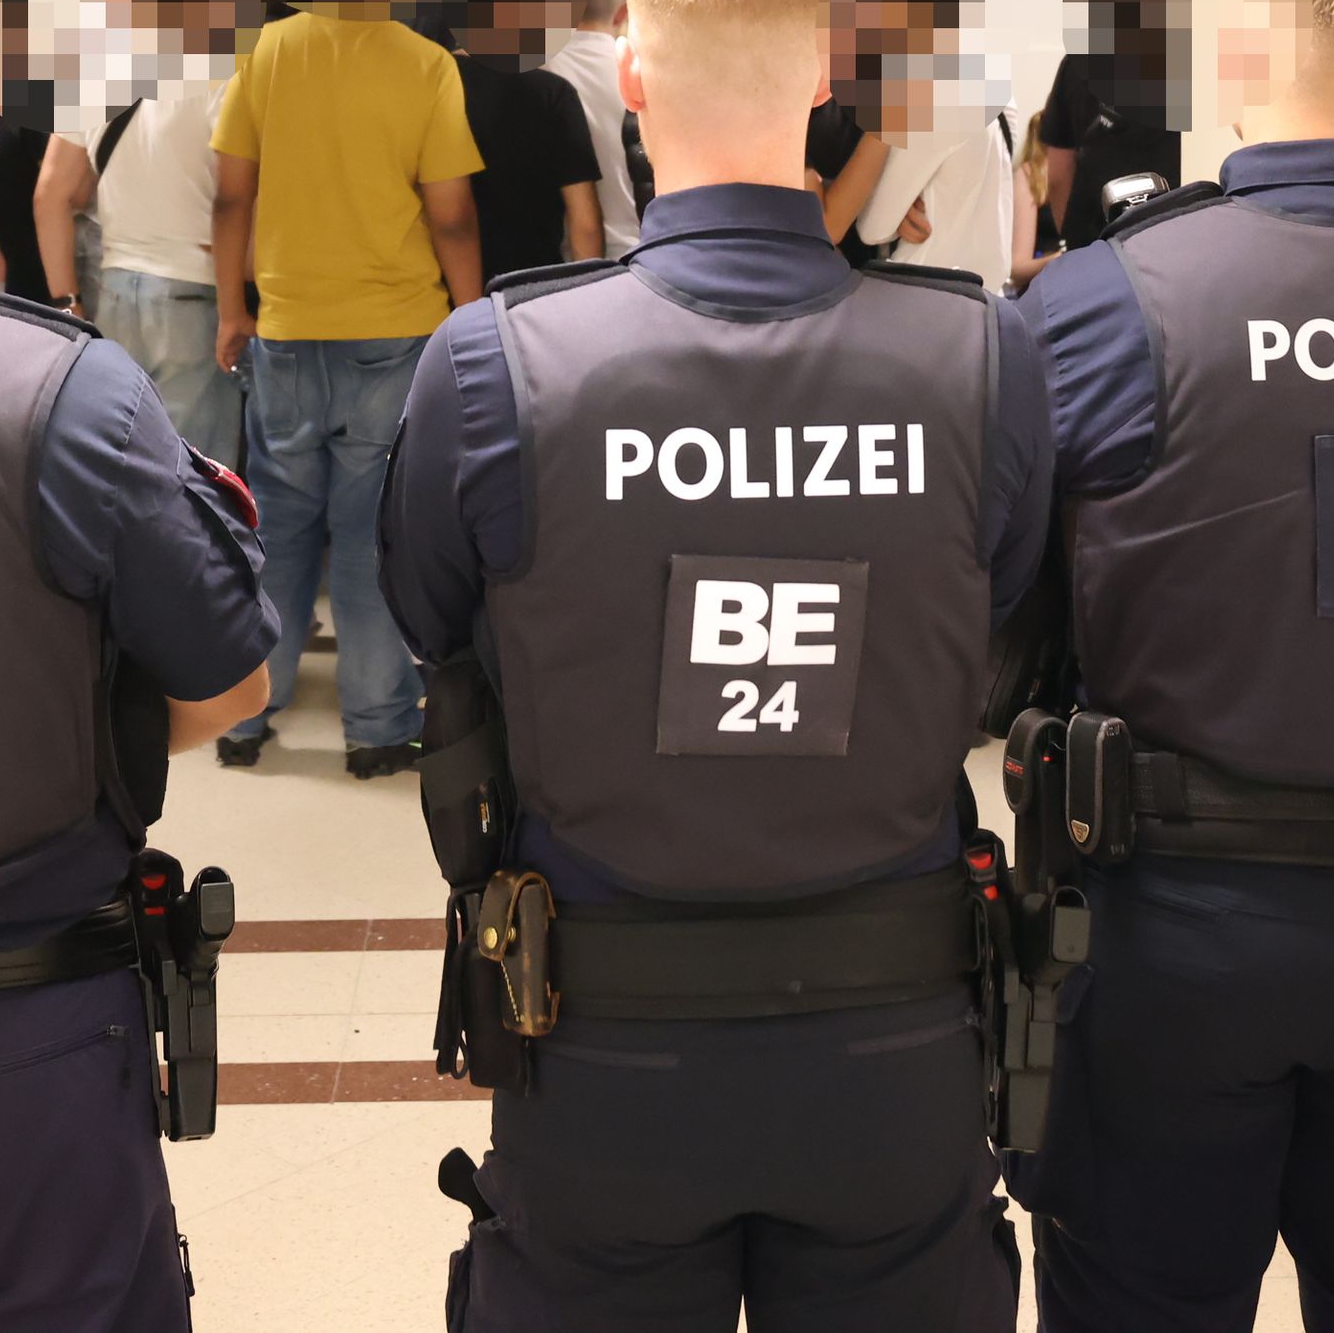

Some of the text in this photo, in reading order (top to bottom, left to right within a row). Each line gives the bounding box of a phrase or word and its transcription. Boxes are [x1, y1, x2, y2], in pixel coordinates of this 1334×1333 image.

[605, 423, 925, 501] POLIZEI
[689, 580, 841, 666] BE
[717, 680, 800, 732] 24
